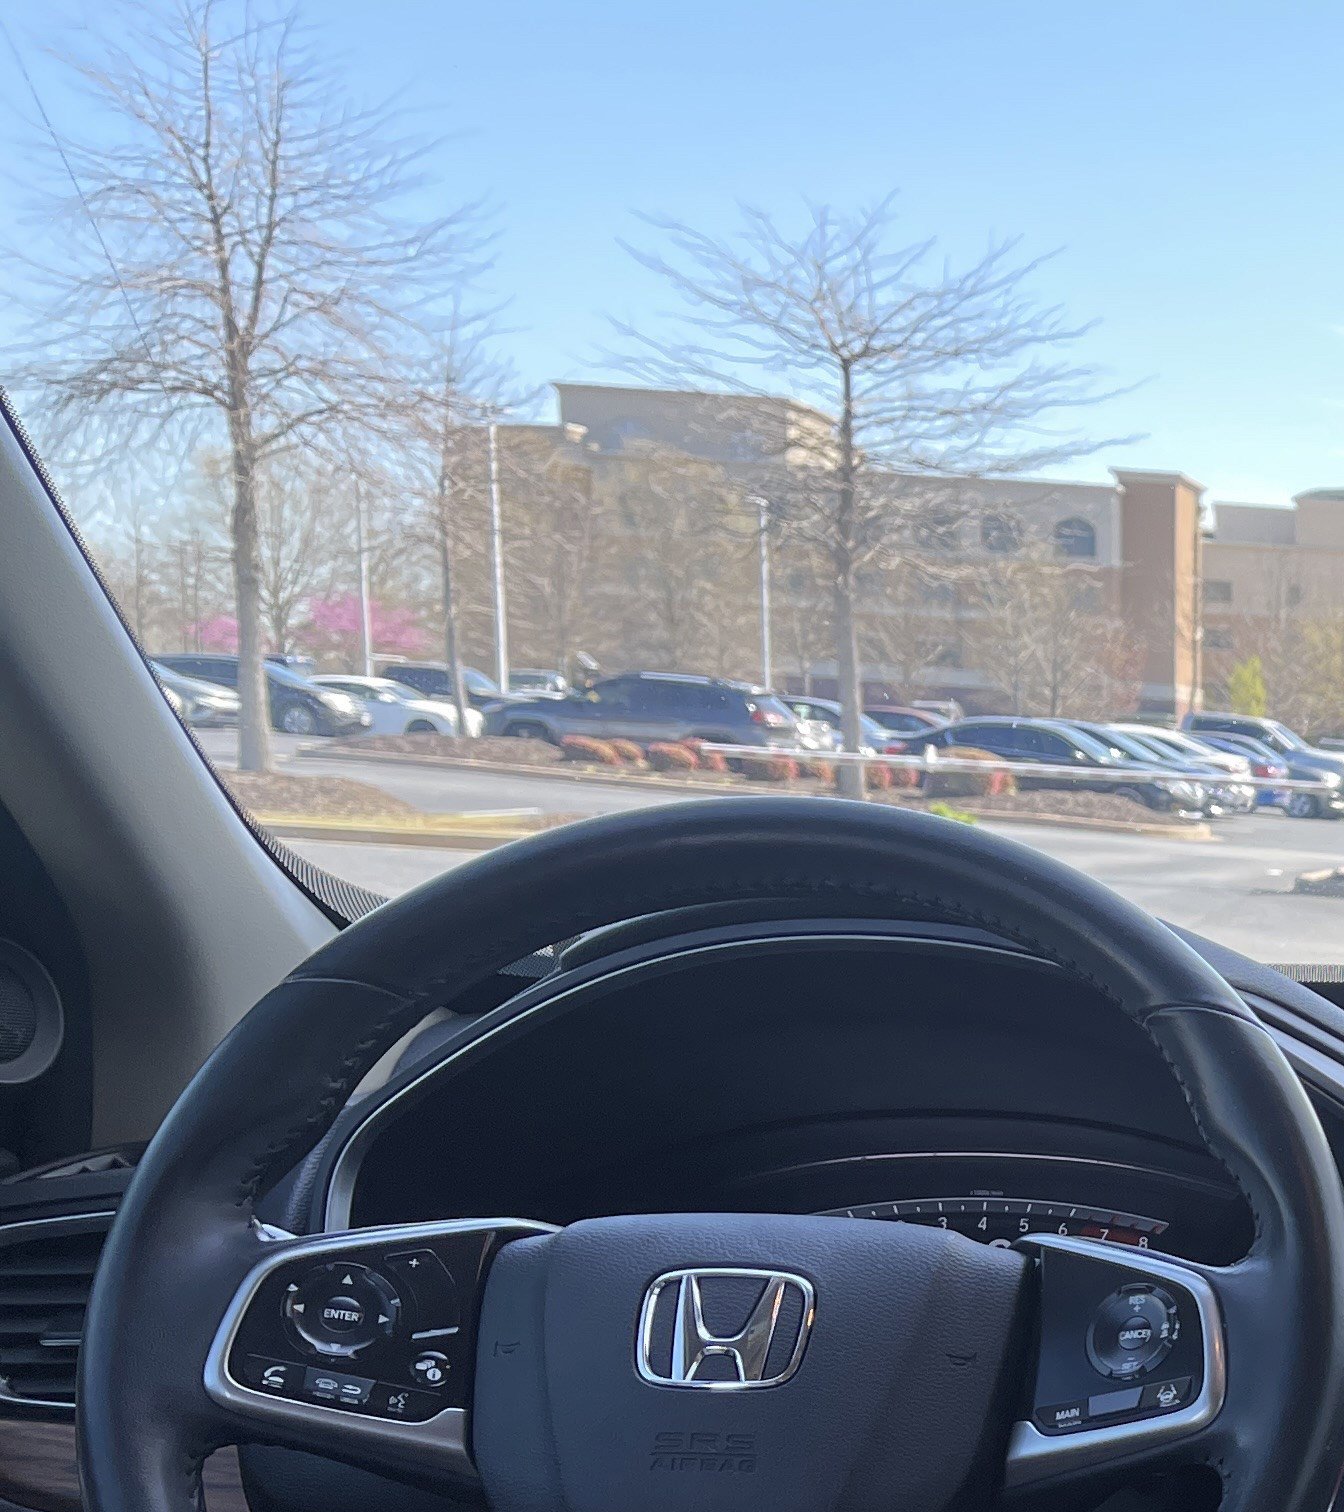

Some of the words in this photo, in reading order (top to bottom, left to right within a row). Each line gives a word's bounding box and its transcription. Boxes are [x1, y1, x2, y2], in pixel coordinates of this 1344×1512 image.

[938, 1217, 947, 1230] 3
[978, 1218, 987, 1231] 4
[1019, 1218, 1029, 1232] 5
[1059, 1222, 1068, 1236] 6
[1100, 1229, 1109, 1241] 7
[1138, 1236, 1148, 1249] 8
[1129, 1294, 1146, 1305] RES
[323, 1308, 362, 1322] ENTER
[1055, 1407, 1080, 1420] MAIN
[654, 1431, 756, 1451] SRS
[651, 1457, 757, 1473] AIRBAG
